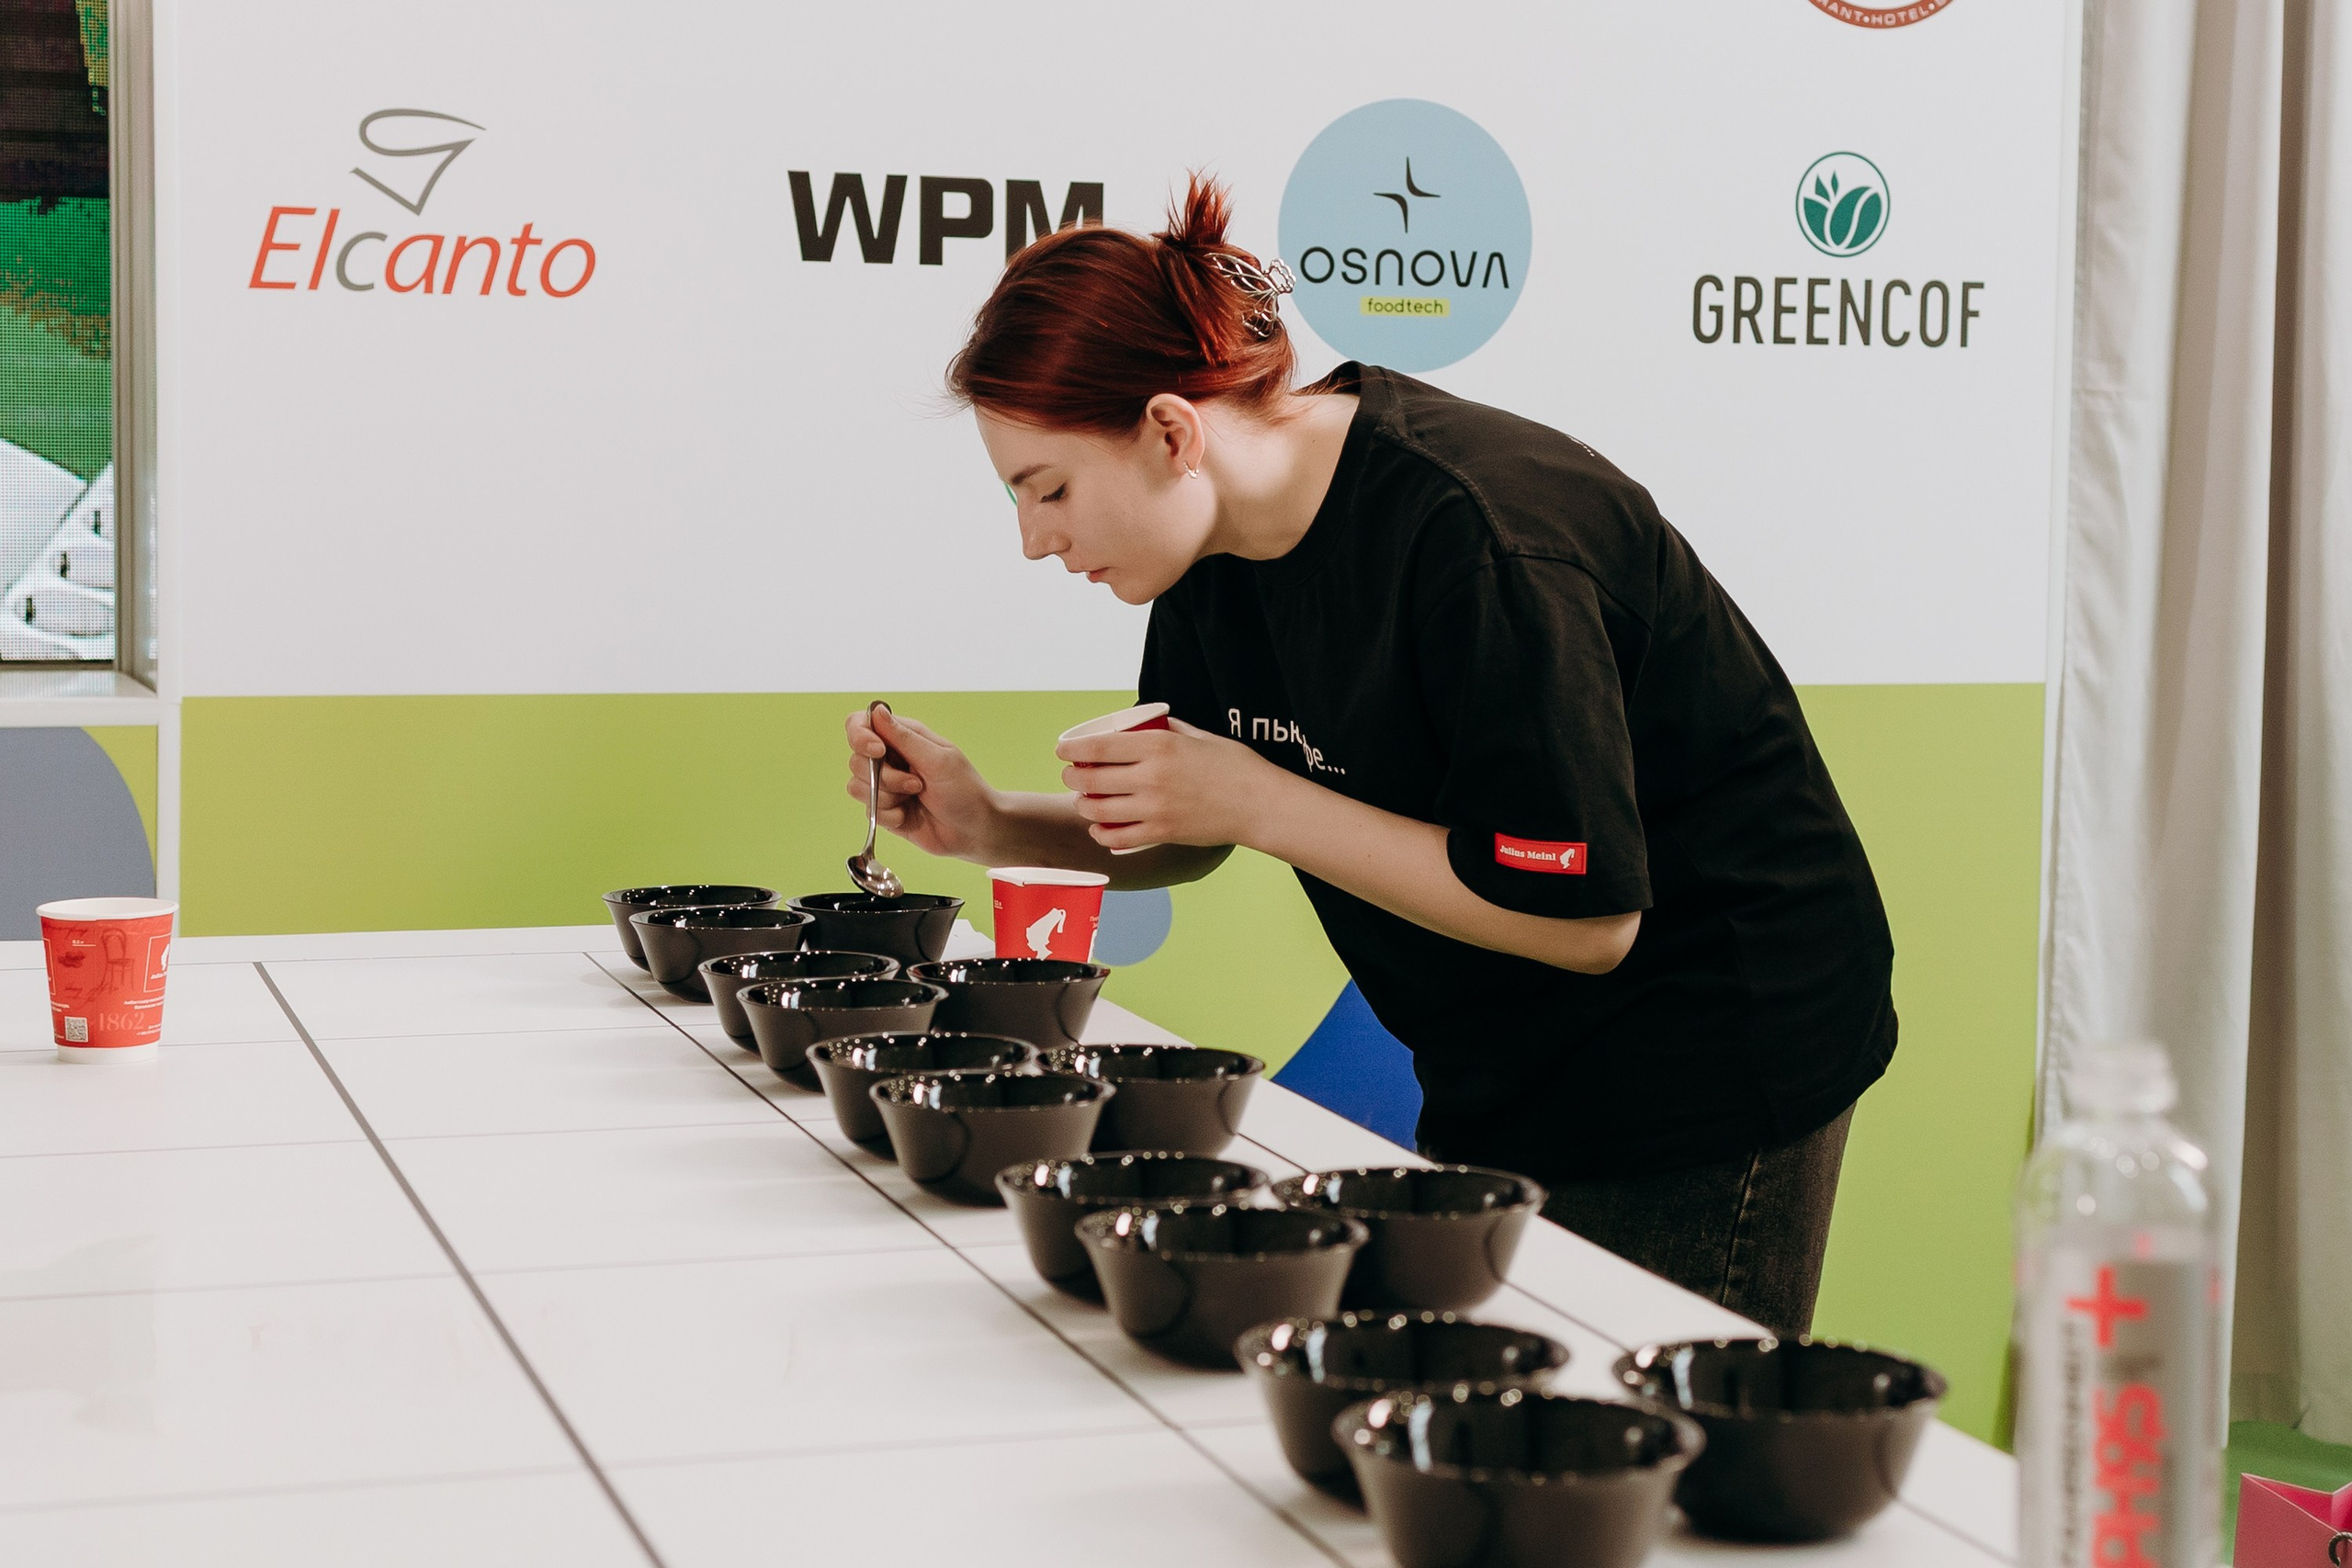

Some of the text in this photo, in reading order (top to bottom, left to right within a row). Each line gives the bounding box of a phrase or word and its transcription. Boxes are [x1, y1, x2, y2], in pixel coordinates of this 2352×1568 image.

[787, 170, 1104, 266] WPM
[248, 205, 596, 299] Elcanto
[1367, 298, 1444, 314] foodtech
[1692, 275, 1985, 348] GREENCOF
[1227, 707, 1241, 739] Я
[1499, 845, 1556, 862] Julius Meinl
[98, 1012, 145, 1032] 1862
